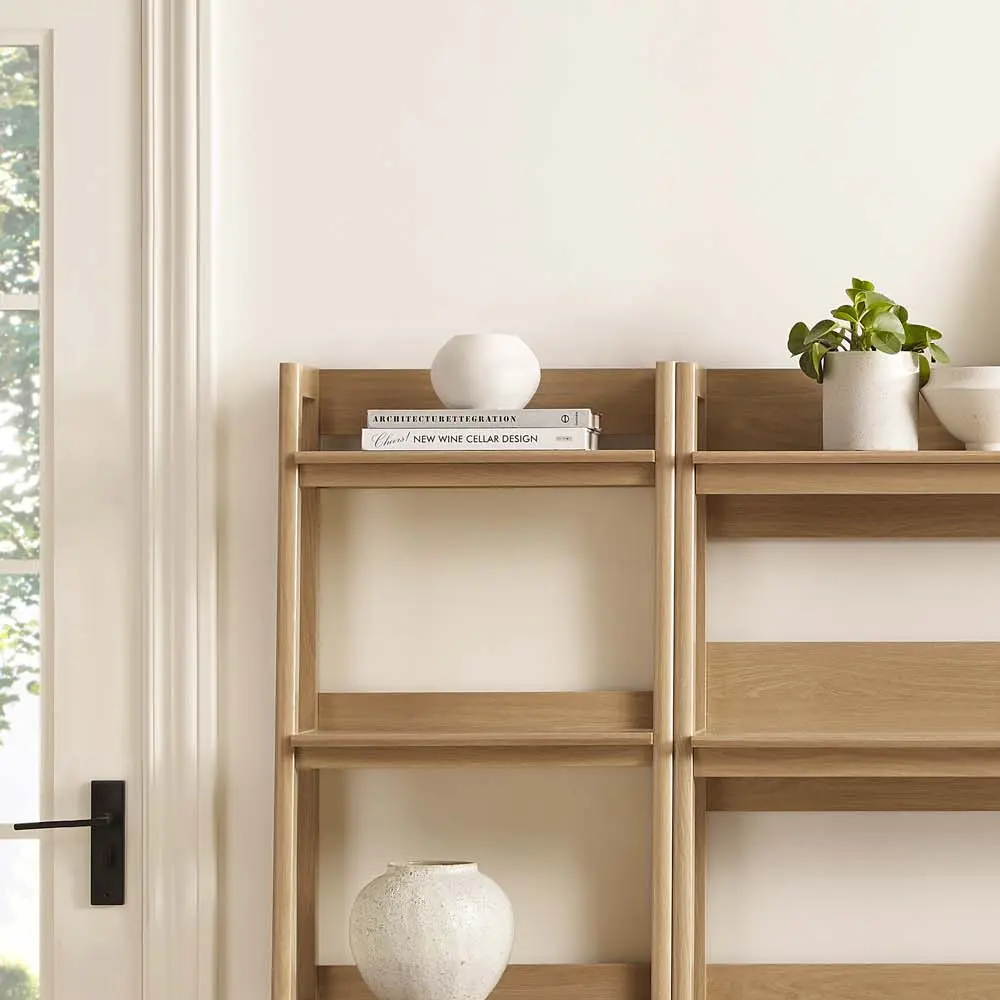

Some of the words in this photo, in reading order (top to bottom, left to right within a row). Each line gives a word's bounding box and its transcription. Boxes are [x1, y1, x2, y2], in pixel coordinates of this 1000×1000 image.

[413, 434, 436, 444] NEW
[438, 434, 463, 444] WINE
[465, 434, 500, 444] CELLAR
[502, 434, 538, 444] DESIGN
